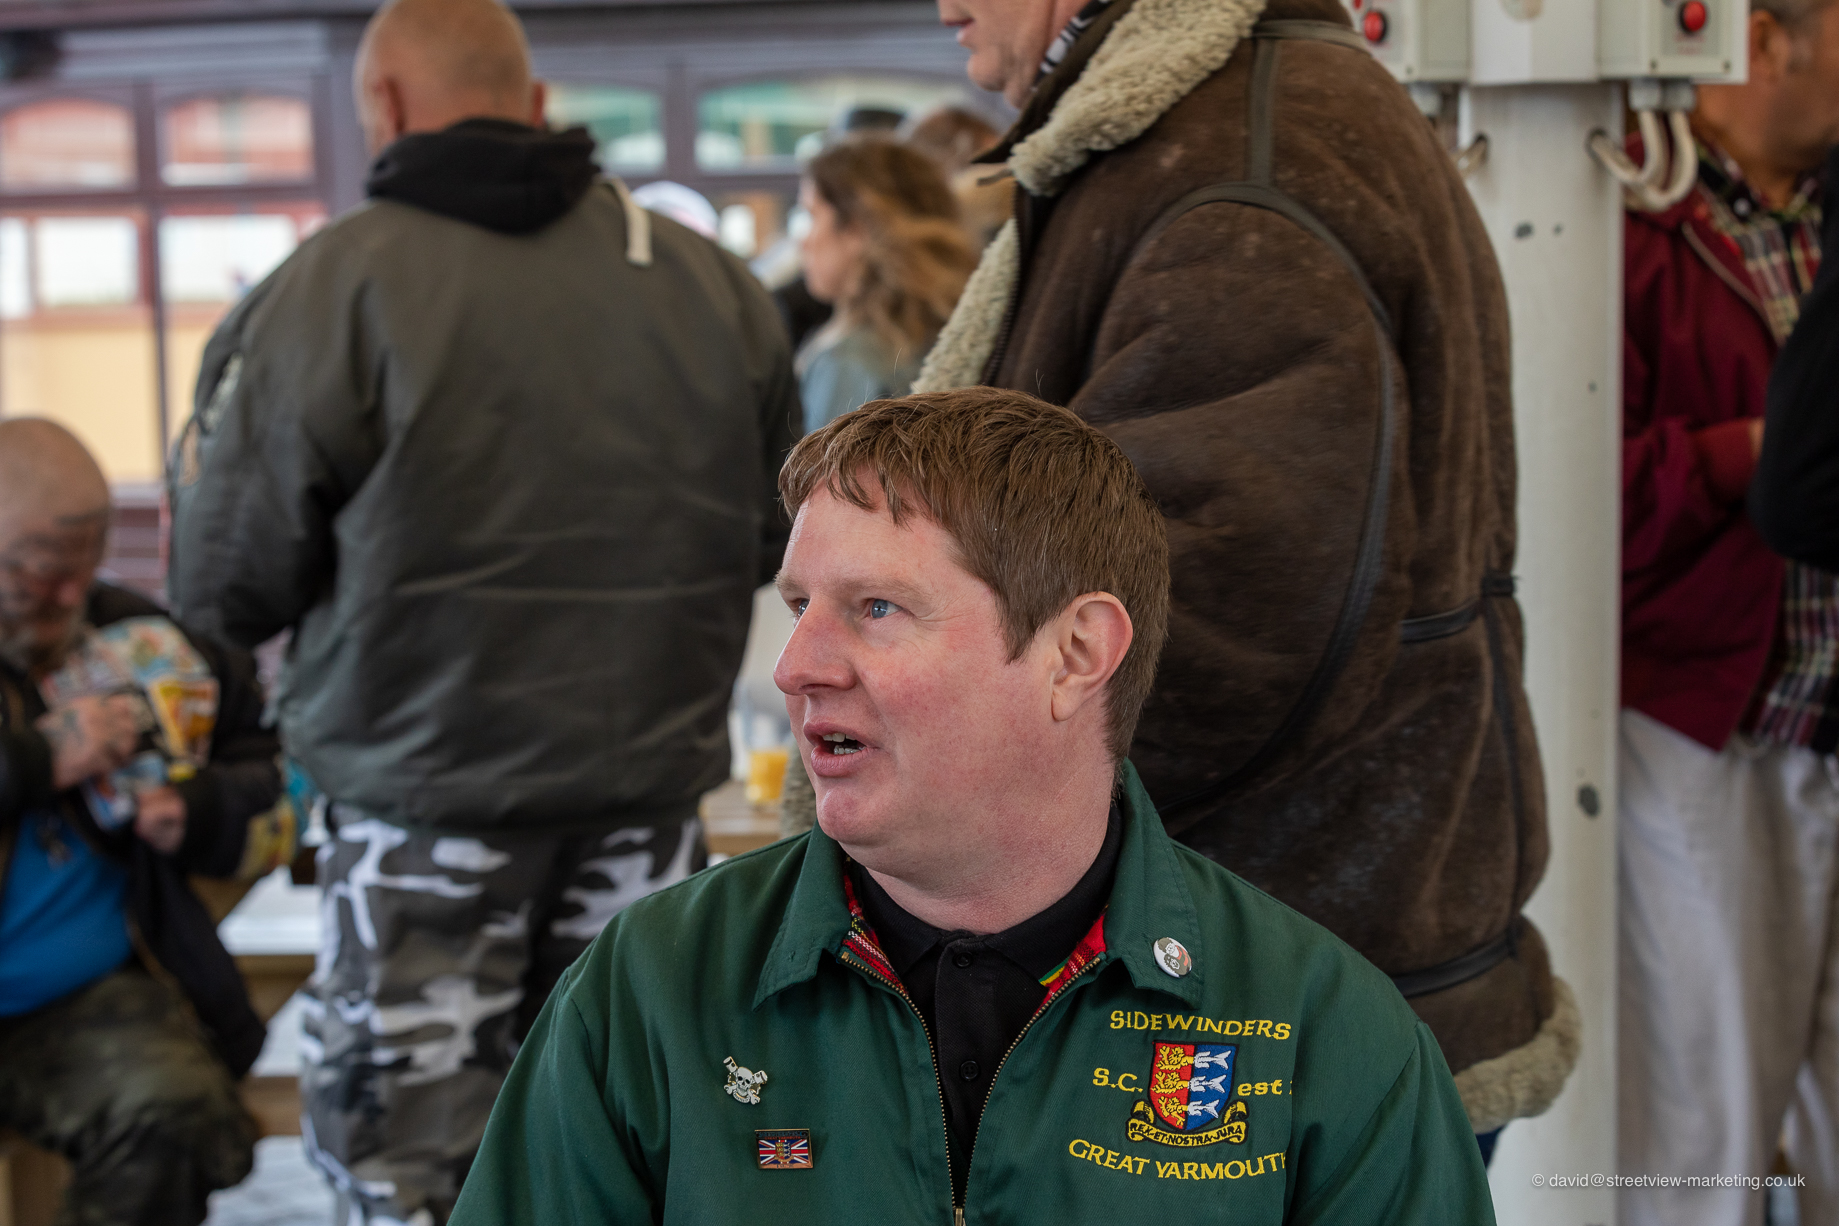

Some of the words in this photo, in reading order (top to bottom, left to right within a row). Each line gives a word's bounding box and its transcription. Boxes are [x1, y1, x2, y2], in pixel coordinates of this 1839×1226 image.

[1110, 1011, 1292, 1040] SIDEWINDERS
[1092, 1067, 1143, 1093] S.C.
[1237, 1079, 1283, 1097] est
[1068, 1139, 1150, 1175] GREAT
